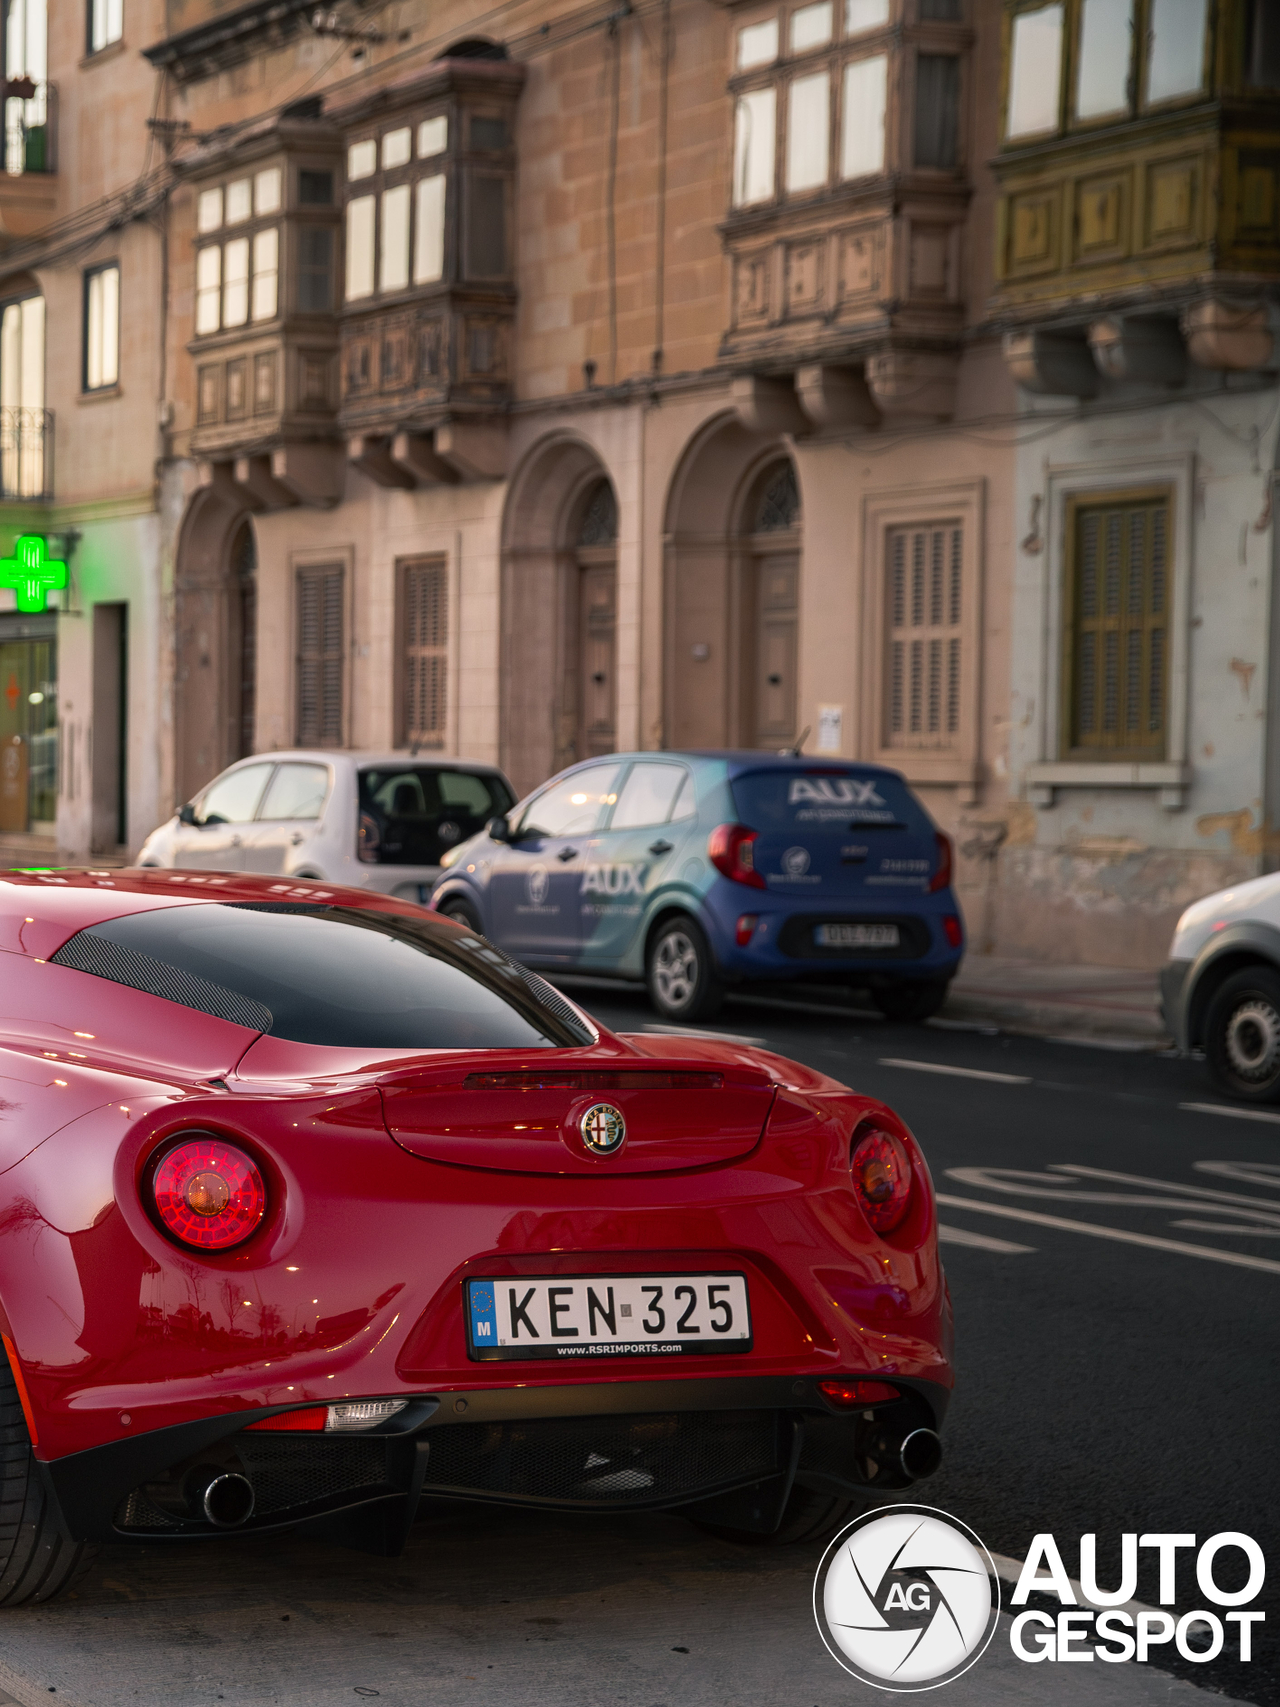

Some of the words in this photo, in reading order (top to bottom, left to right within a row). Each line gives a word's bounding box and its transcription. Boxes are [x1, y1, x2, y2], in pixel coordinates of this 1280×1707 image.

[788, 779, 886, 807] AUX
[579, 863, 646, 895] AUX
[586, 1110, 599, 1130] ALFA
[602, 1107, 624, 1129] ROMEO
[508, 1287, 617, 1338] KEN
[641, 1285, 733, 1334] 325
[477, 1322, 491, 1336] M
[557, 1343, 682, 1355] www.RSRIMPORTS.com
